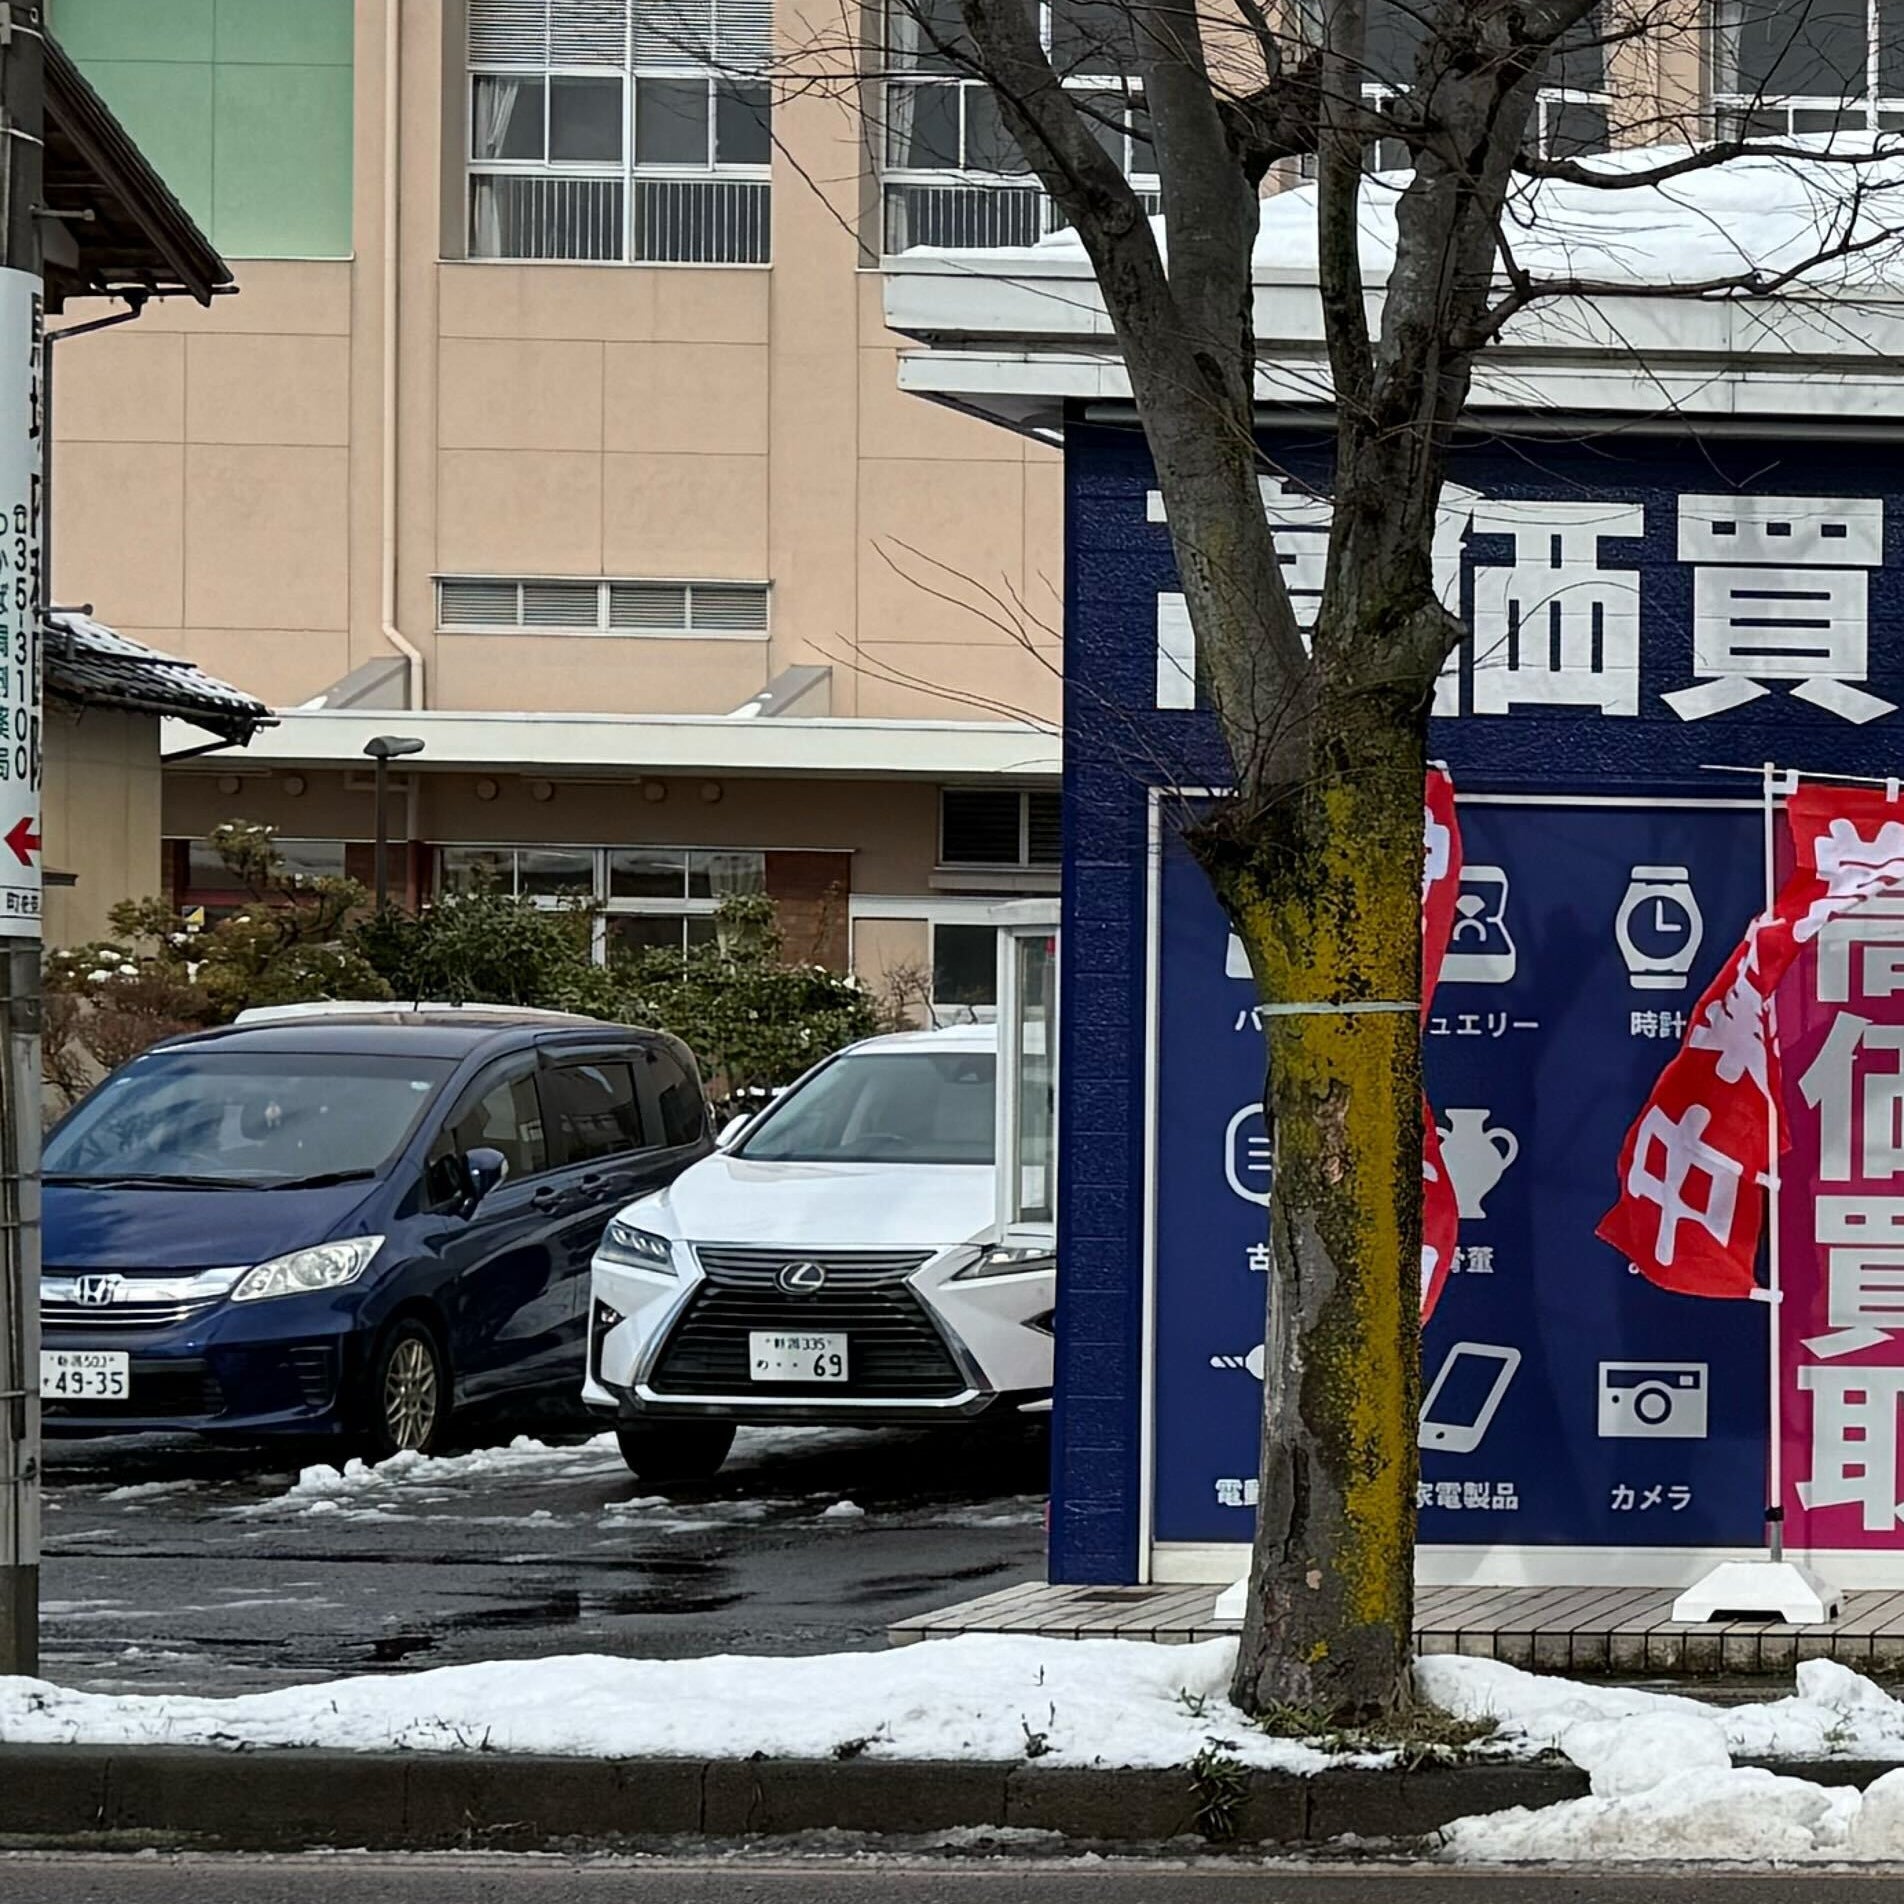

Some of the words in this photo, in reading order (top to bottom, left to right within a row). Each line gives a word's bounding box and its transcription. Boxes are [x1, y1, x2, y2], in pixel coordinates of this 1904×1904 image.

[14, 537, 28, 780] 35-3100
[1430, 1012, 1539, 1037] ュエリー
[1630, 1010, 1687, 1039] 時計
[55, 1370, 124, 1395] 49-35
[1610, 1483, 1694, 1511] カメラ
